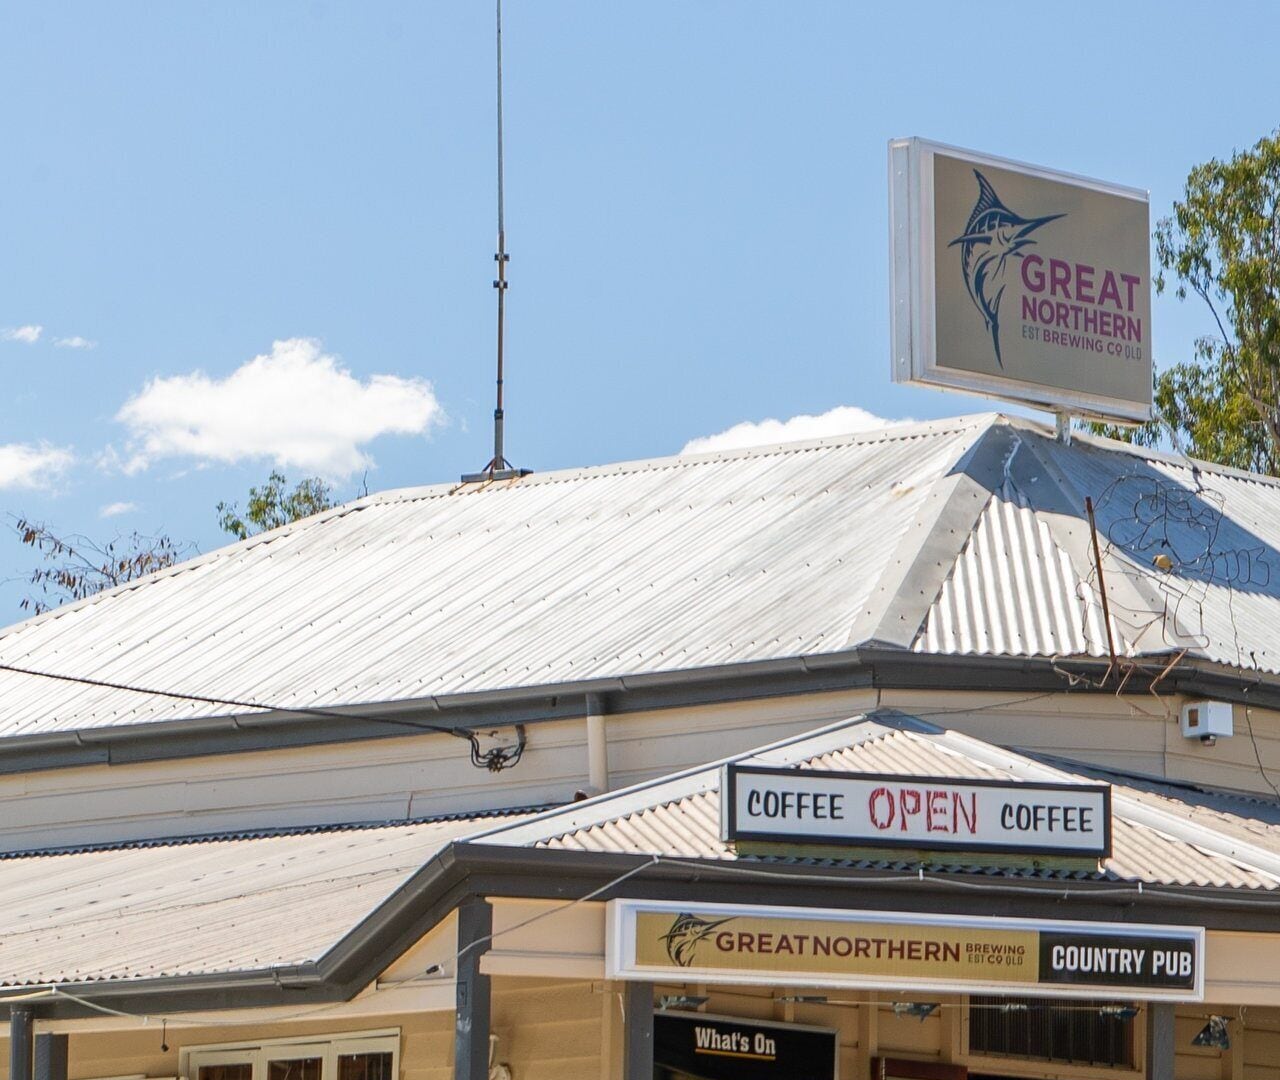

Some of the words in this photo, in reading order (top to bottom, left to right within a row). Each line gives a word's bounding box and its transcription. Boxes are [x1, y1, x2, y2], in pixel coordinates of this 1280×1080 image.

[1021, 254, 1141, 312] GREAT
[1022, 295, 1142, 343] NORTHERN
[1022, 325, 1040, 341] EST
[1043, 329, 1103, 353] BREWING
[1125, 345, 1142, 360] QLD
[747, 789, 845, 820] COFFEE
[868, 787, 976, 834] OPEN
[1000, 804, 1094, 833] COFFEE
[716, 931, 810, 955] GREAT
[812, 936, 961, 963] NORTHERN
[965, 943, 1026, 955] BREWING
[1052, 944, 1146, 974] COUNTRY
[1152, 951, 1192, 977] PUB
[695, 1026, 750, 1053] What's
[755, 1033, 776, 1056] On
